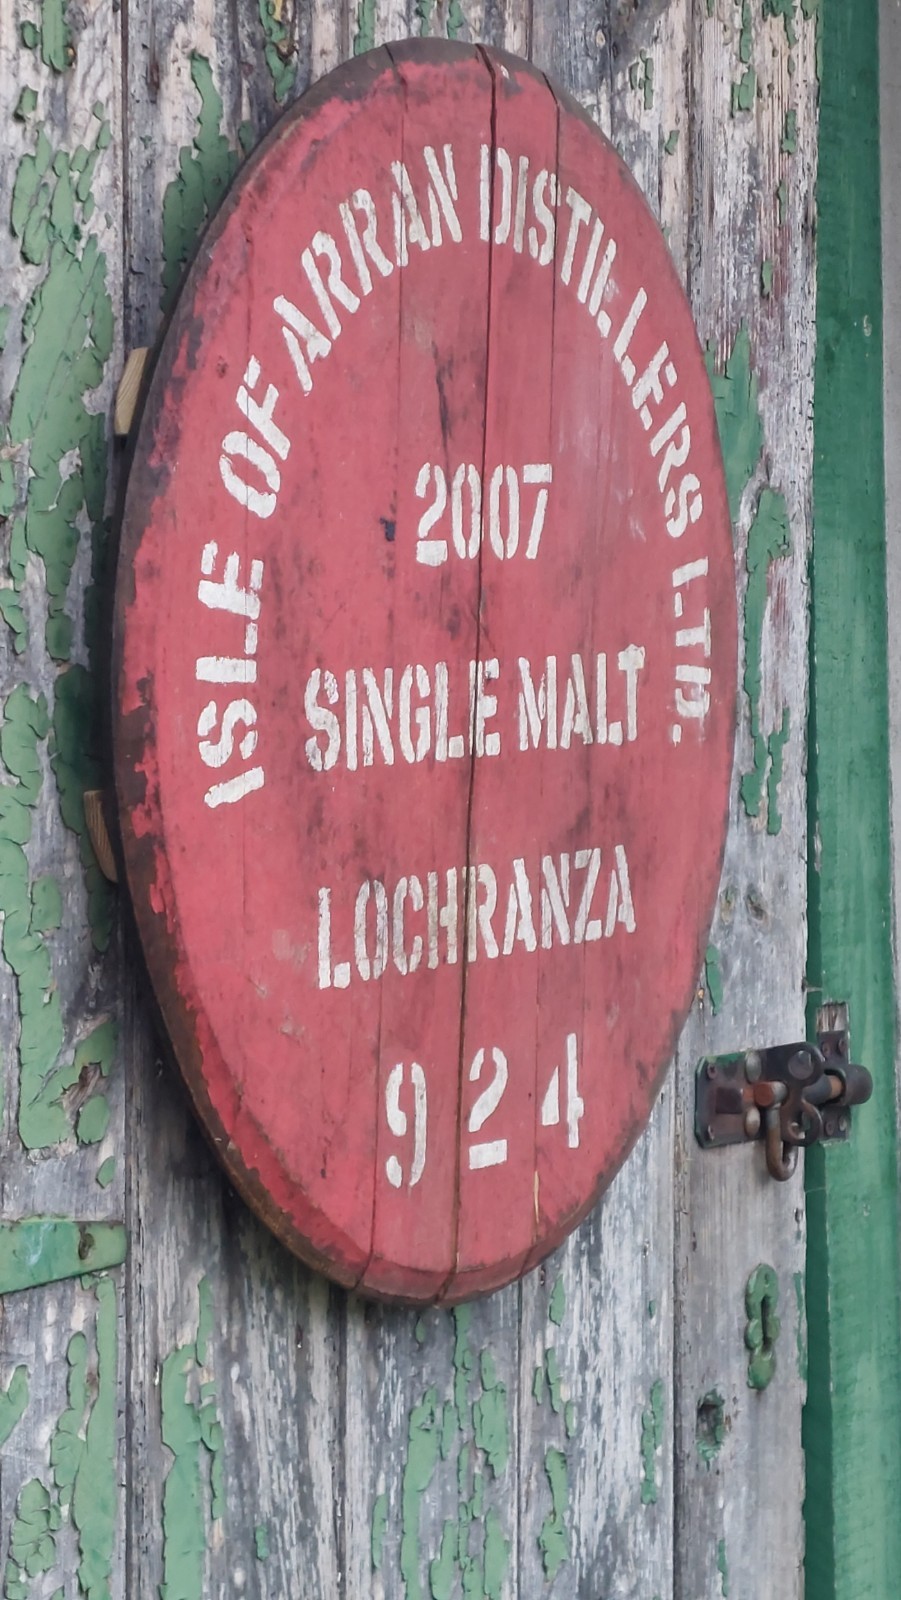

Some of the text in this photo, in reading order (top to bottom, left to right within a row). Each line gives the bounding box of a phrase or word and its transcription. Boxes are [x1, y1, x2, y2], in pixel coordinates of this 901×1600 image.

[273, 143, 463, 397] ARRAN
[479, 143, 703, 539] DISTILLERS
[218, 354, 291, 519] OF
[414, 462, 553, 567] 2007
[195, 540, 265, 809] ISLE
[304, 643, 646, 772] SINGLE MALT
[317, 844, 636, 990] LOCHRANZA
